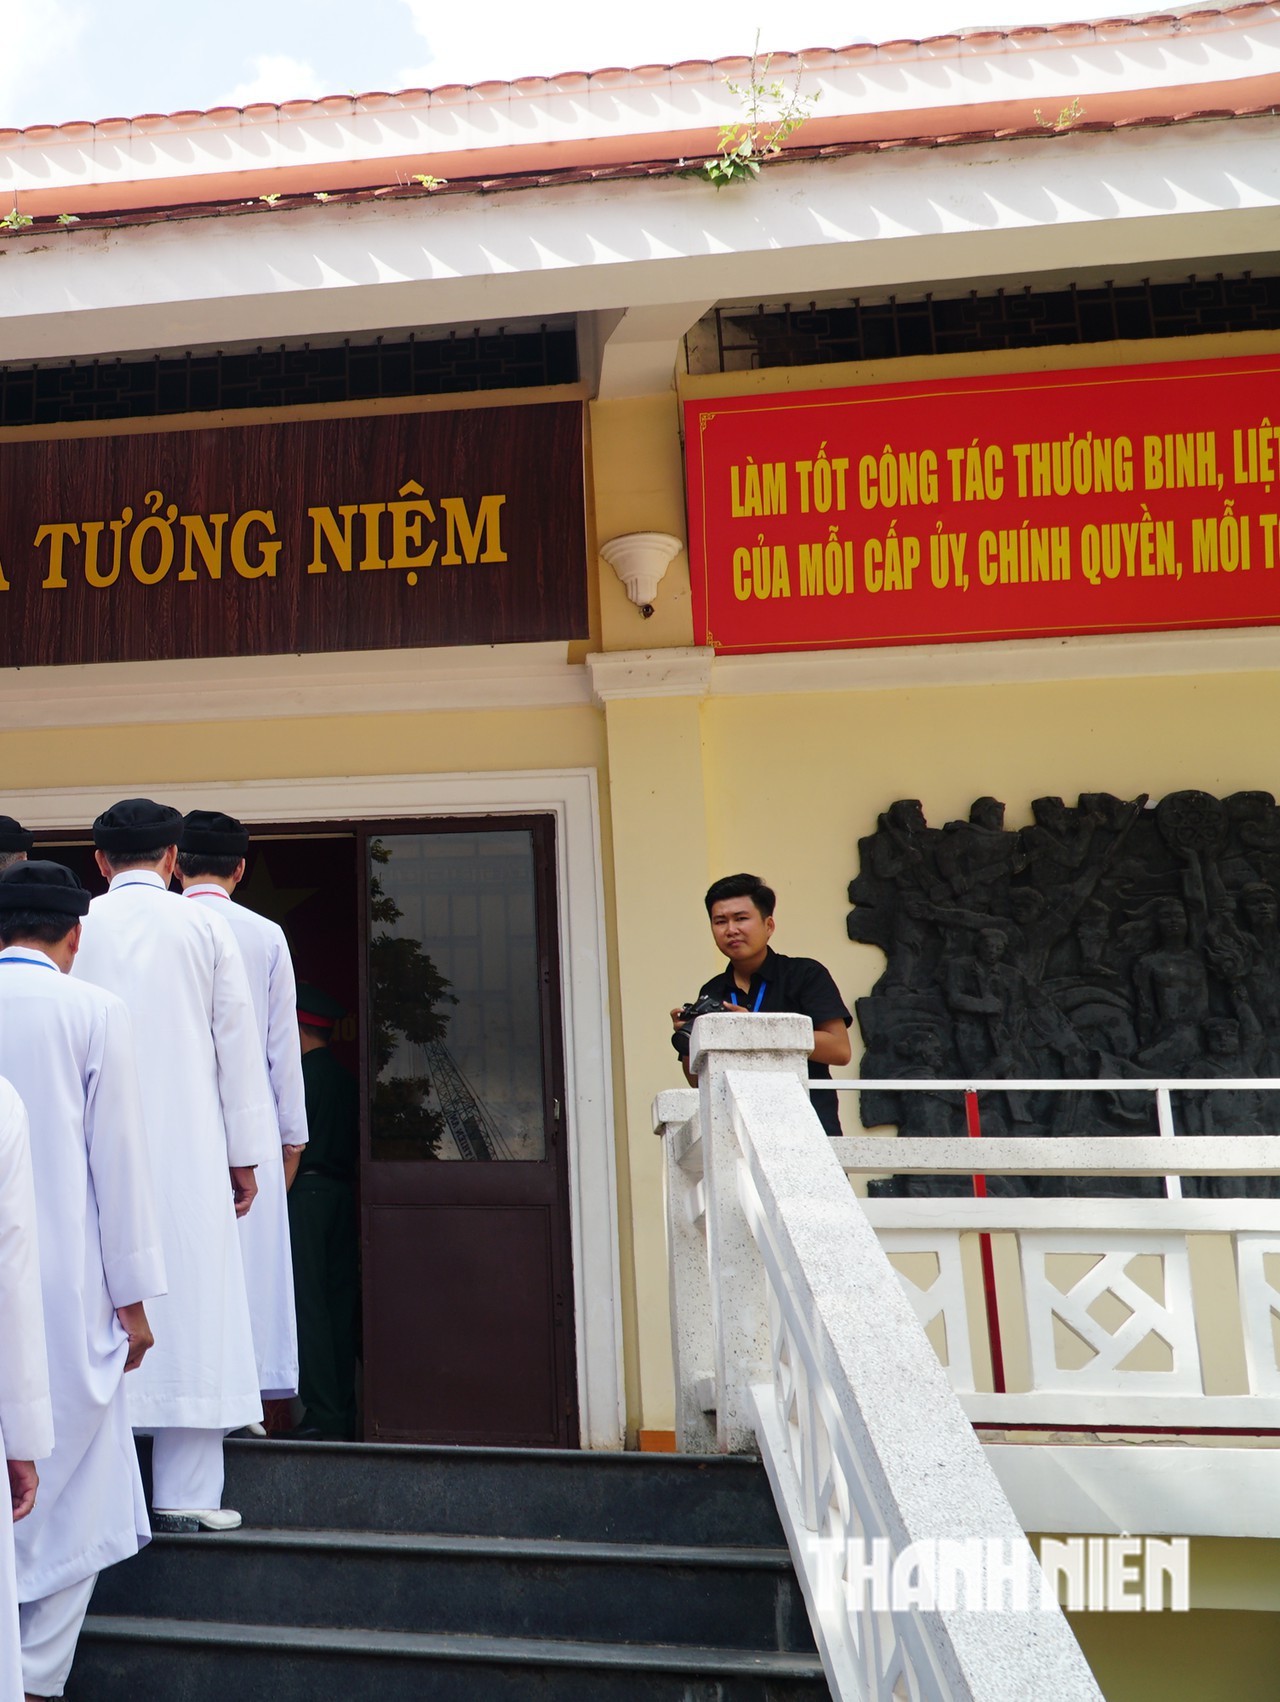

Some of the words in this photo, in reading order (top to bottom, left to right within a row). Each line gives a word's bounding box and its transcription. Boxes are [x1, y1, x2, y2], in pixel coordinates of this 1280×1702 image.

[730, 456, 787, 518] LÀM
[795, 441, 849, 514] TỐT
[858, 444, 939, 510] CÔNG
[946, 438, 1005, 502] TÁC
[1012, 431, 1134, 498] THƯƠNG
[1143, 431, 1224, 492] BINH,
[33, 490, 283, 589] TƯỞNG
[307, 479, 509, 587] NIỆM
[732, 533, 792, 601] CỦA
[798, 524, 855, 597] MỖI
[863, 518, 921, 593] CẤP
[929, 520, 970, 593] ỦY,
[978, 519, 1071, 587] CHÍNH
[1080, 503, 1183, 585] QUYỀN,
[1191, 498, 1251, 574] MỖI
